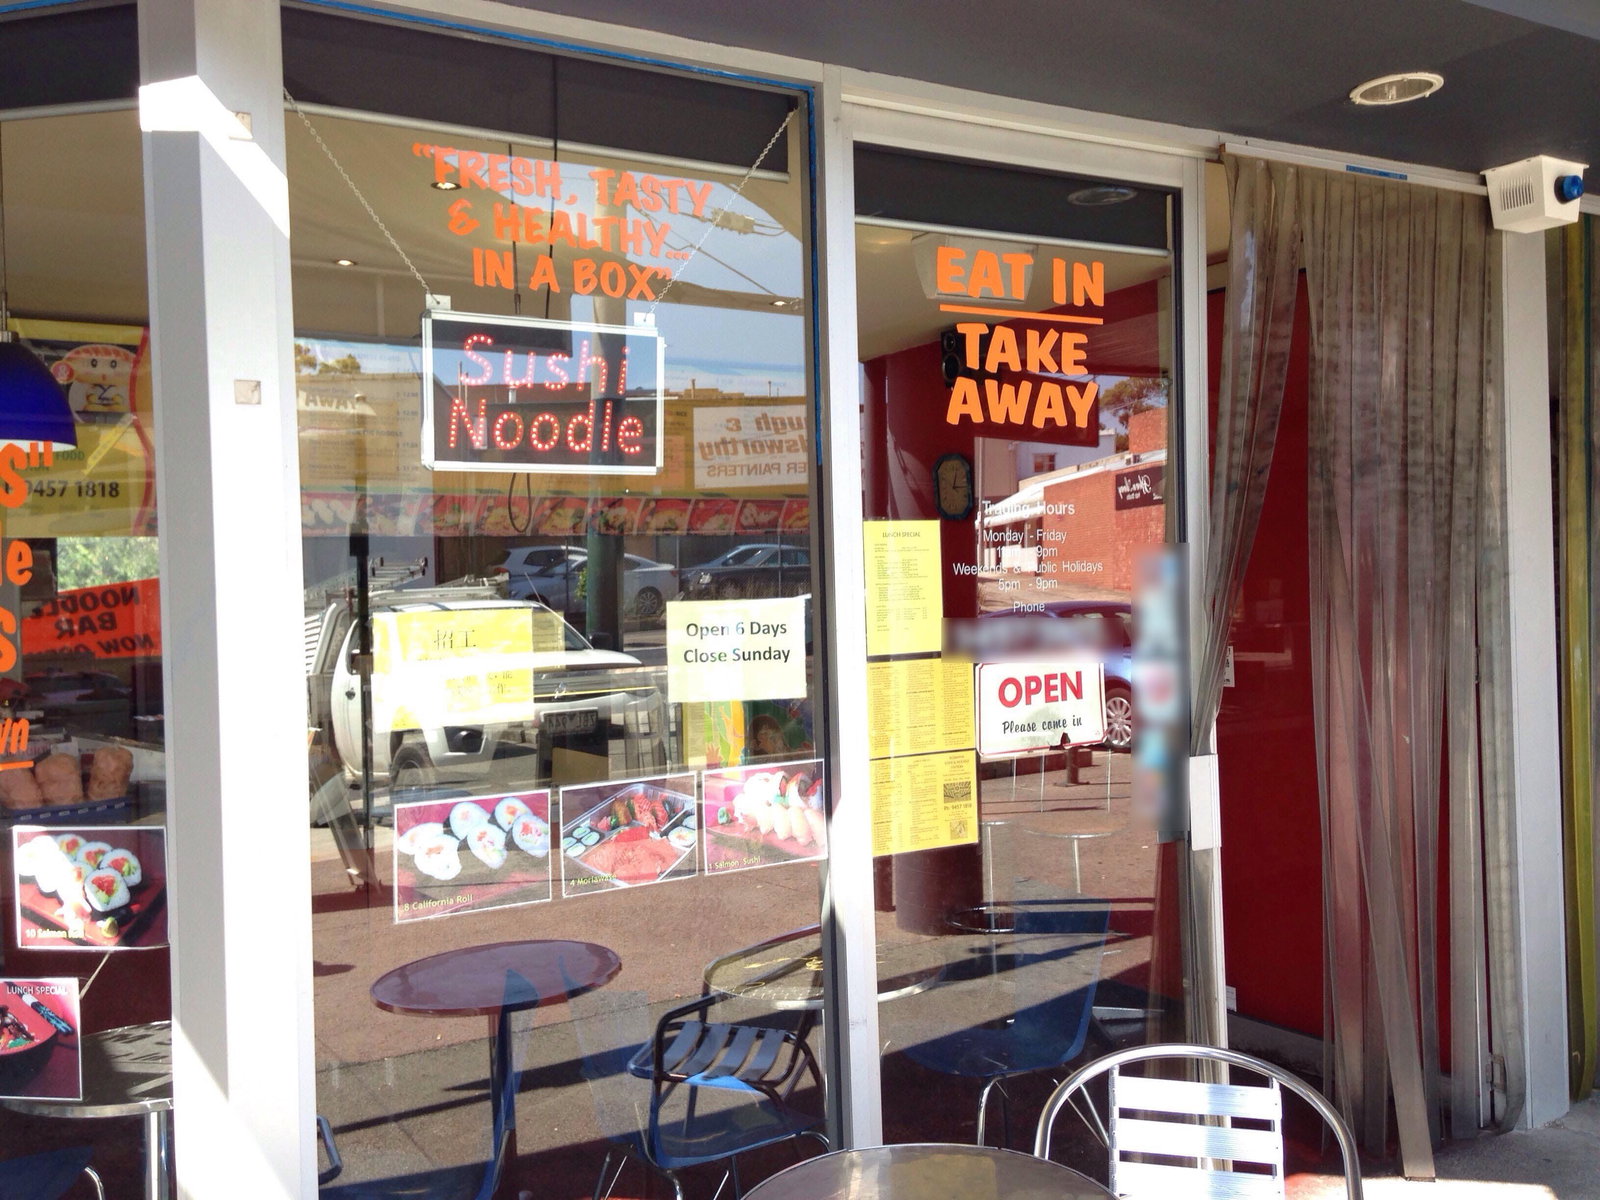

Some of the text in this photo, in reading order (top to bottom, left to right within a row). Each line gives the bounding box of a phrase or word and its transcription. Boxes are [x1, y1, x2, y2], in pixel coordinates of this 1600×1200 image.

[588, 169, 714, 217] TASTY
[447, 198, 480, 236] &
[471, 247, 515, 290] IN
[528, 253, 561, 293] A
[936, 246, 1105, 307] EAT IN
[956, 322, 1089, 376] TAKE
[460, 333, 631, 396] Sushi
[946, 376, 1099, 429] AWAY
[448, 398, 645, 455] Noodle
[77, 481, 120, 498] 1818
[1038, 501, 1075, 515] Hours
[982, 529, 1024, 543] Monday
[1036, 528, 1067, 544] Friday
[1035, 545, 1058, 559] 9pm
[952, 562, 1008, 576] Weekends
[1028, 561, 1058, 573] ublic
[1062, 560, 1104, 575] Holidays
[1035, 577, 1058, 592] 9pm
[1013, 600, 1046, 613] Phone
[686, 621, 788, 640] Open 6 Days
[683, 646, 791, 663] Close Sunday
[997, 670, 1084, 708] OPEN
[1001, 714, 1083, 734] Please come in
[714, 859, 740, 870] Salmon
[743, 855, 761, 866] Sushi
[412, 896, 454, 910] California
[456, 894, 473, 904] Roll
[6, 985, 68, 995] LUNCH SPECIAL
